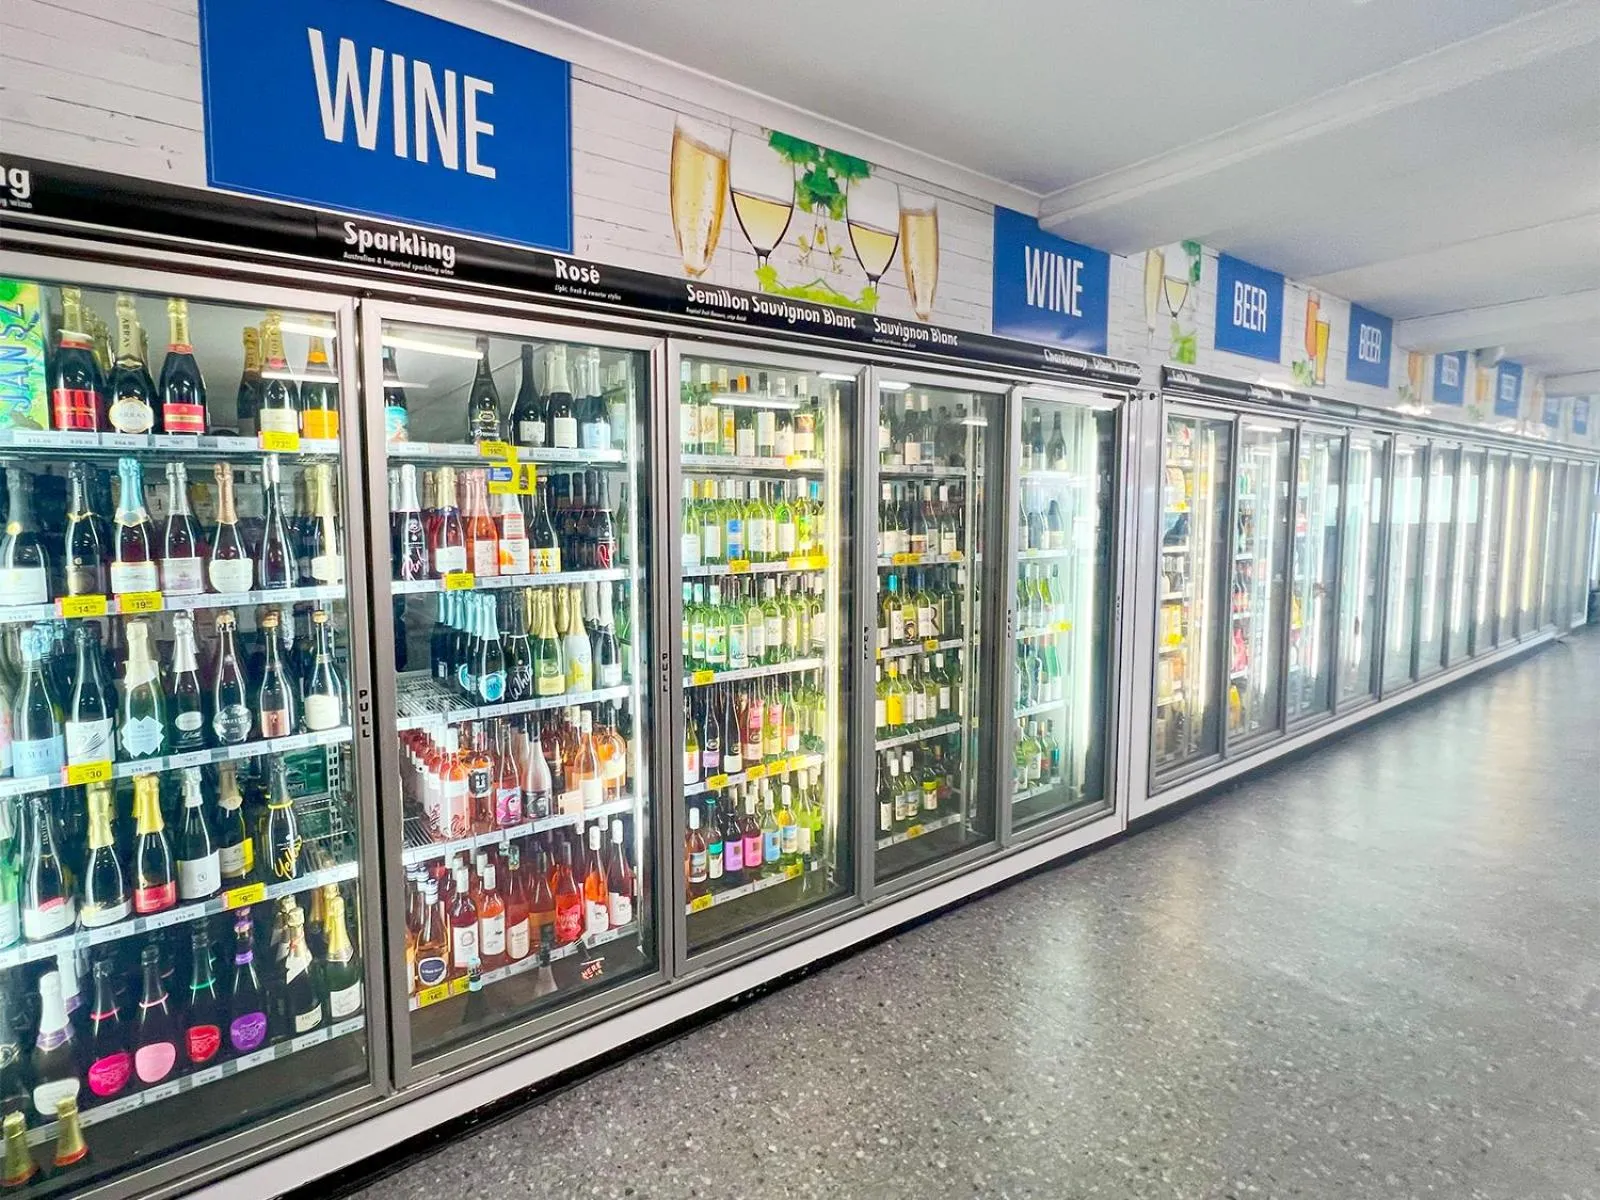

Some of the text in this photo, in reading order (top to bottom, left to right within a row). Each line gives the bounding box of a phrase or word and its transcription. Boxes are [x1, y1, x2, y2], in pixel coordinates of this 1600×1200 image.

[308, 27, 496, 179] WINE
[0, 164, 31, 199] g
[343, 221, 456, 269] Sparkling
[1025, 245, 1084, 318] WINE
[686, 284, 856, 330] Semillon Sauvignon Blanc
[1233, 280, 1267, 333] BEER
[873, 317, 929, 341] Sauvignon
[930, 327, 958, 346] Blanc
[1359, 323, 1383, 364] BEER
[359, 689, 370, 738] PULL
